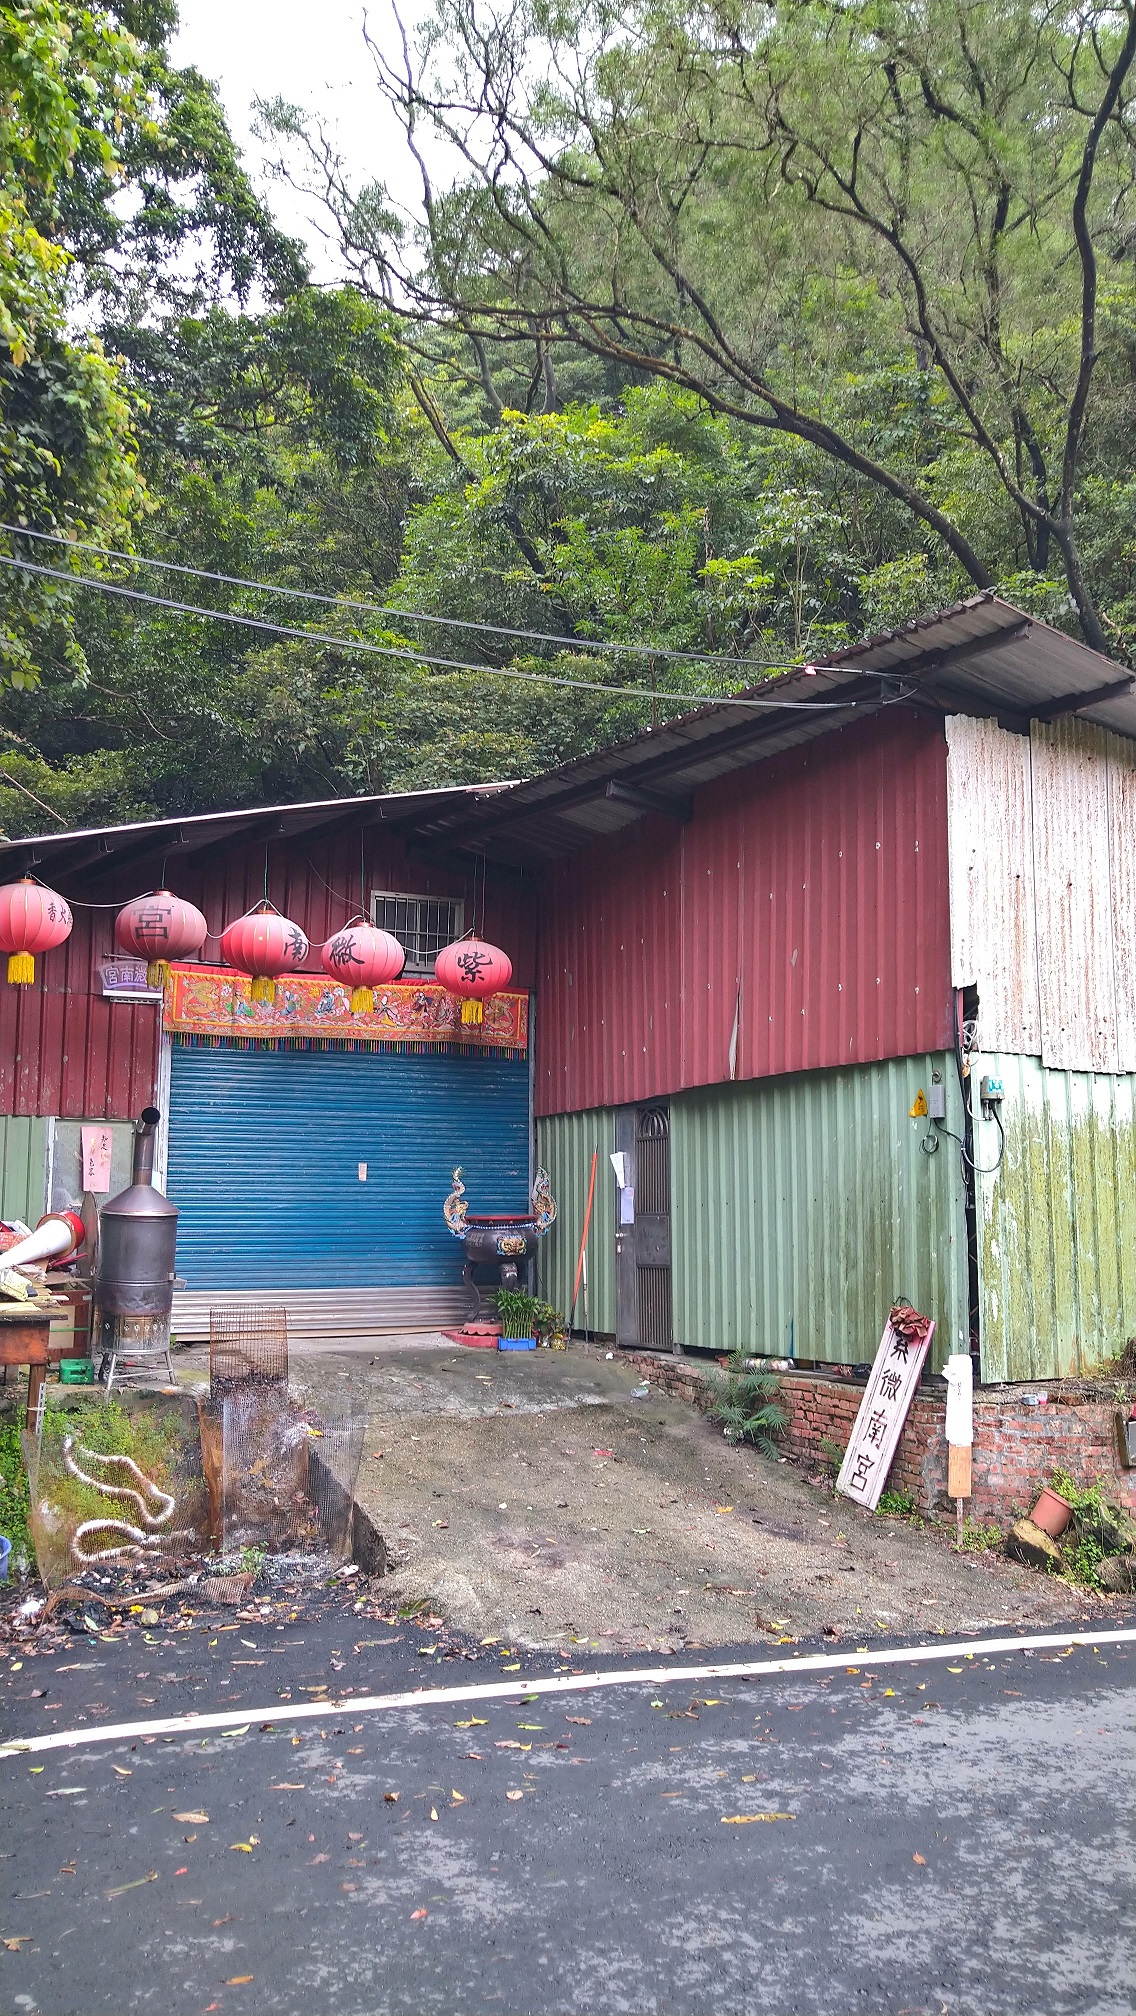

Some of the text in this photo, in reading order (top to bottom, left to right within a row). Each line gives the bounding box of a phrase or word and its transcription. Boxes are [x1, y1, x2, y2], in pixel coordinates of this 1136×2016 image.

[132, 905, 172, 940] 宮
[283, 928, 309, 962] 南
[329, 934, 365, 969] 微
[457, 950, 494, 984] 紫
